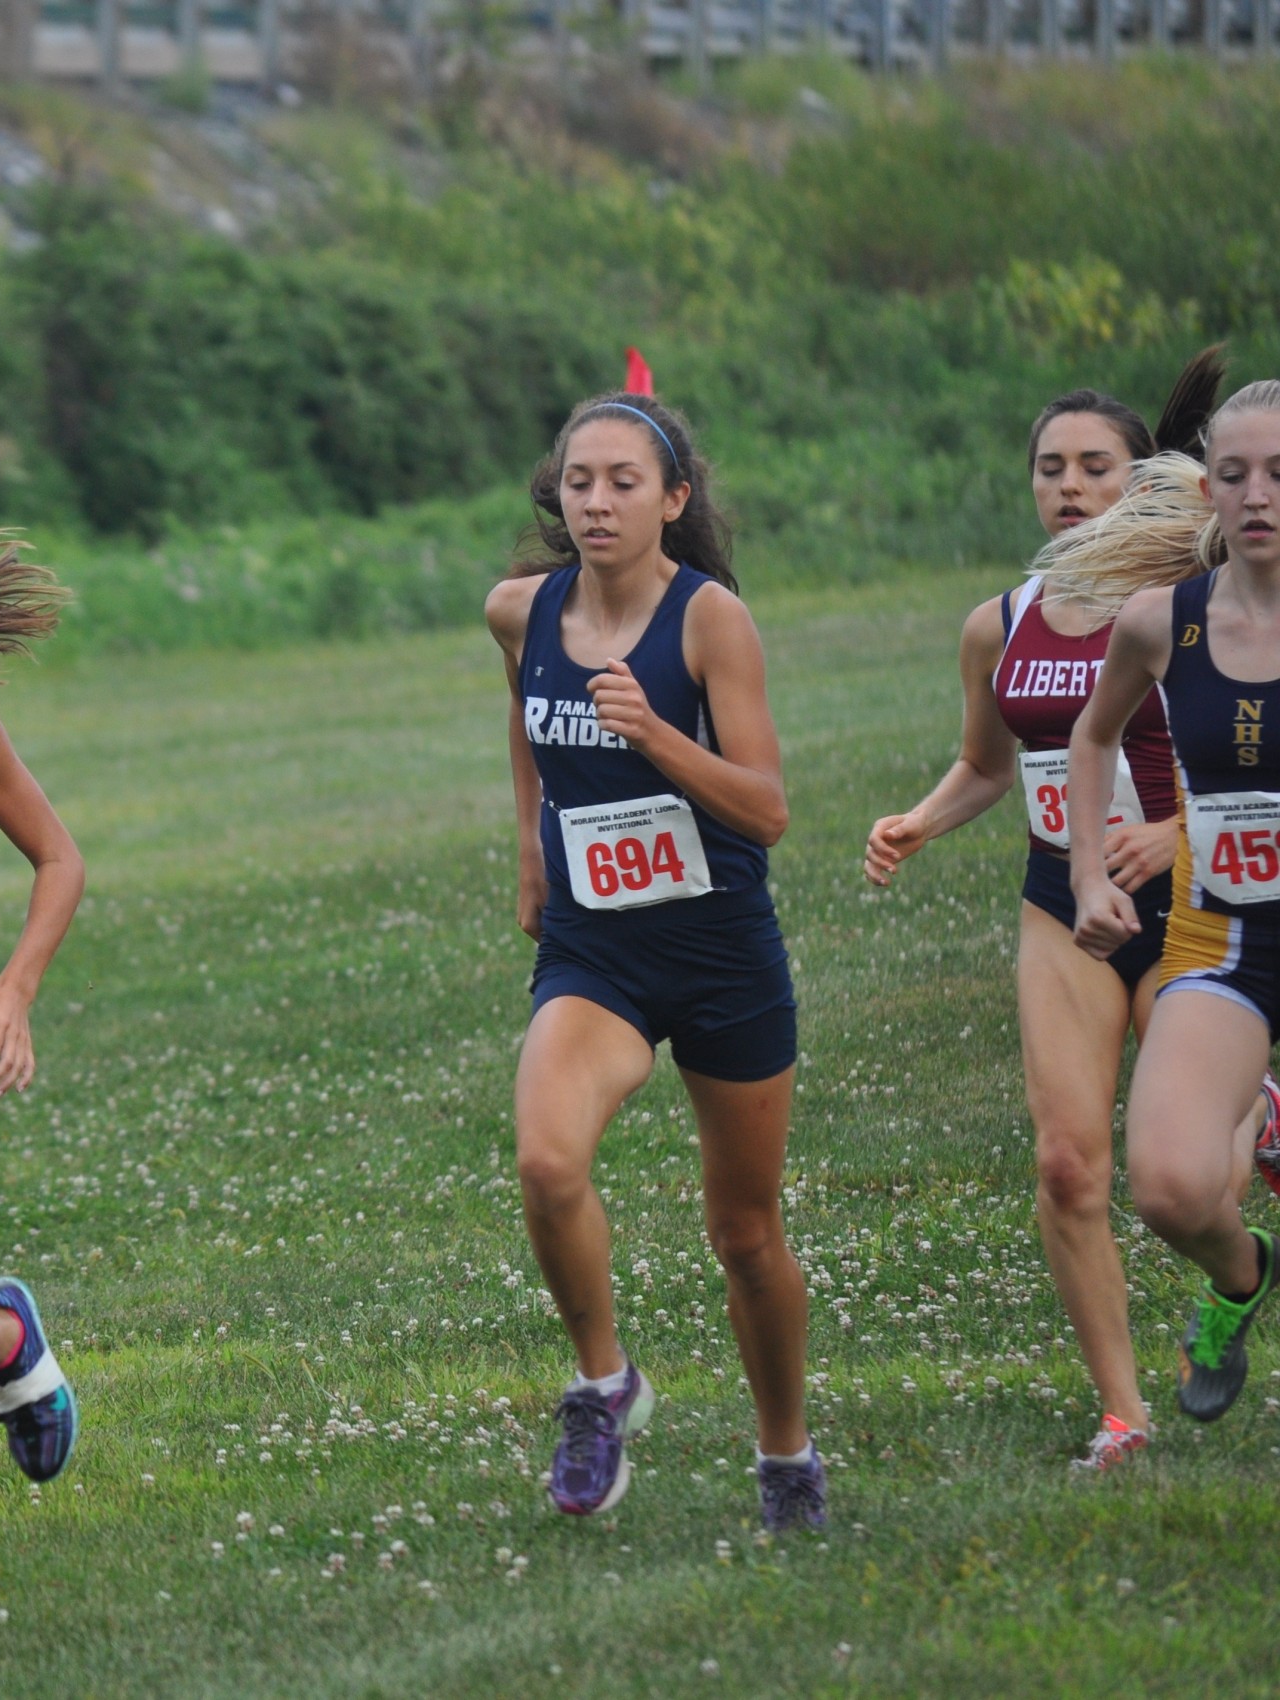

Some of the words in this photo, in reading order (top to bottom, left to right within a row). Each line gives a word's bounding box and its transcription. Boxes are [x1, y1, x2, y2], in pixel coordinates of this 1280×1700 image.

[1006, 659, 1105, 697] LIBERT
[525, 696, 630, 749] RAIDE
[554, 700, 596, 717] TAMA
[570, 815, 611, 826] MORAVIAN
[613, 808, 652, 820] ACADEMY
[655, 804, 680, 813] LIONS
[597, 818, 654, 832] INVITATIONAL
[586, 832, 685, 896] 694
[1211, 830, 1280, 885] 45
